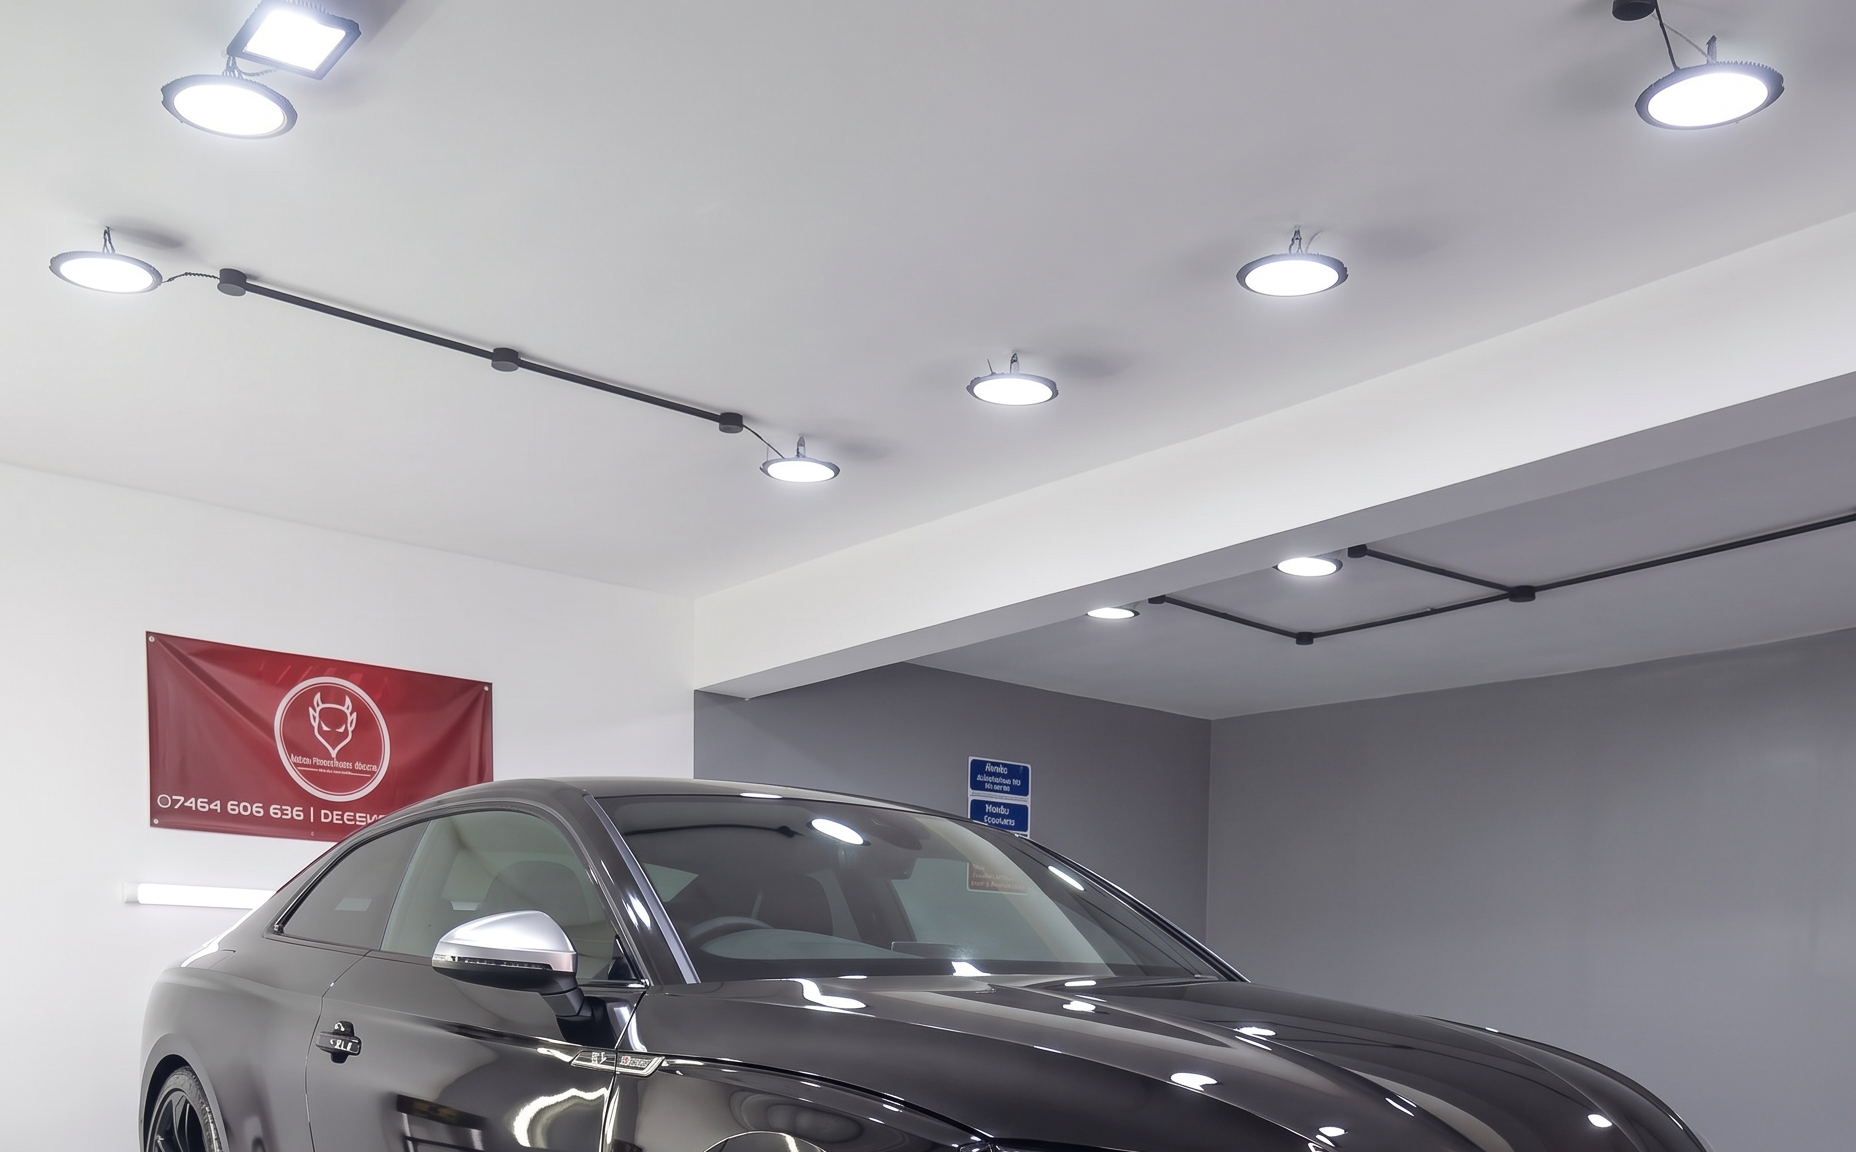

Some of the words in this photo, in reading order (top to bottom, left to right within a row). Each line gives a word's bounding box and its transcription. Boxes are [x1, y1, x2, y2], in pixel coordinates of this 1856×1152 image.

[157, 794, 221, 813] 07464
[227, 800, 264, 817] 606
[269, 804, 304, 821] 636
